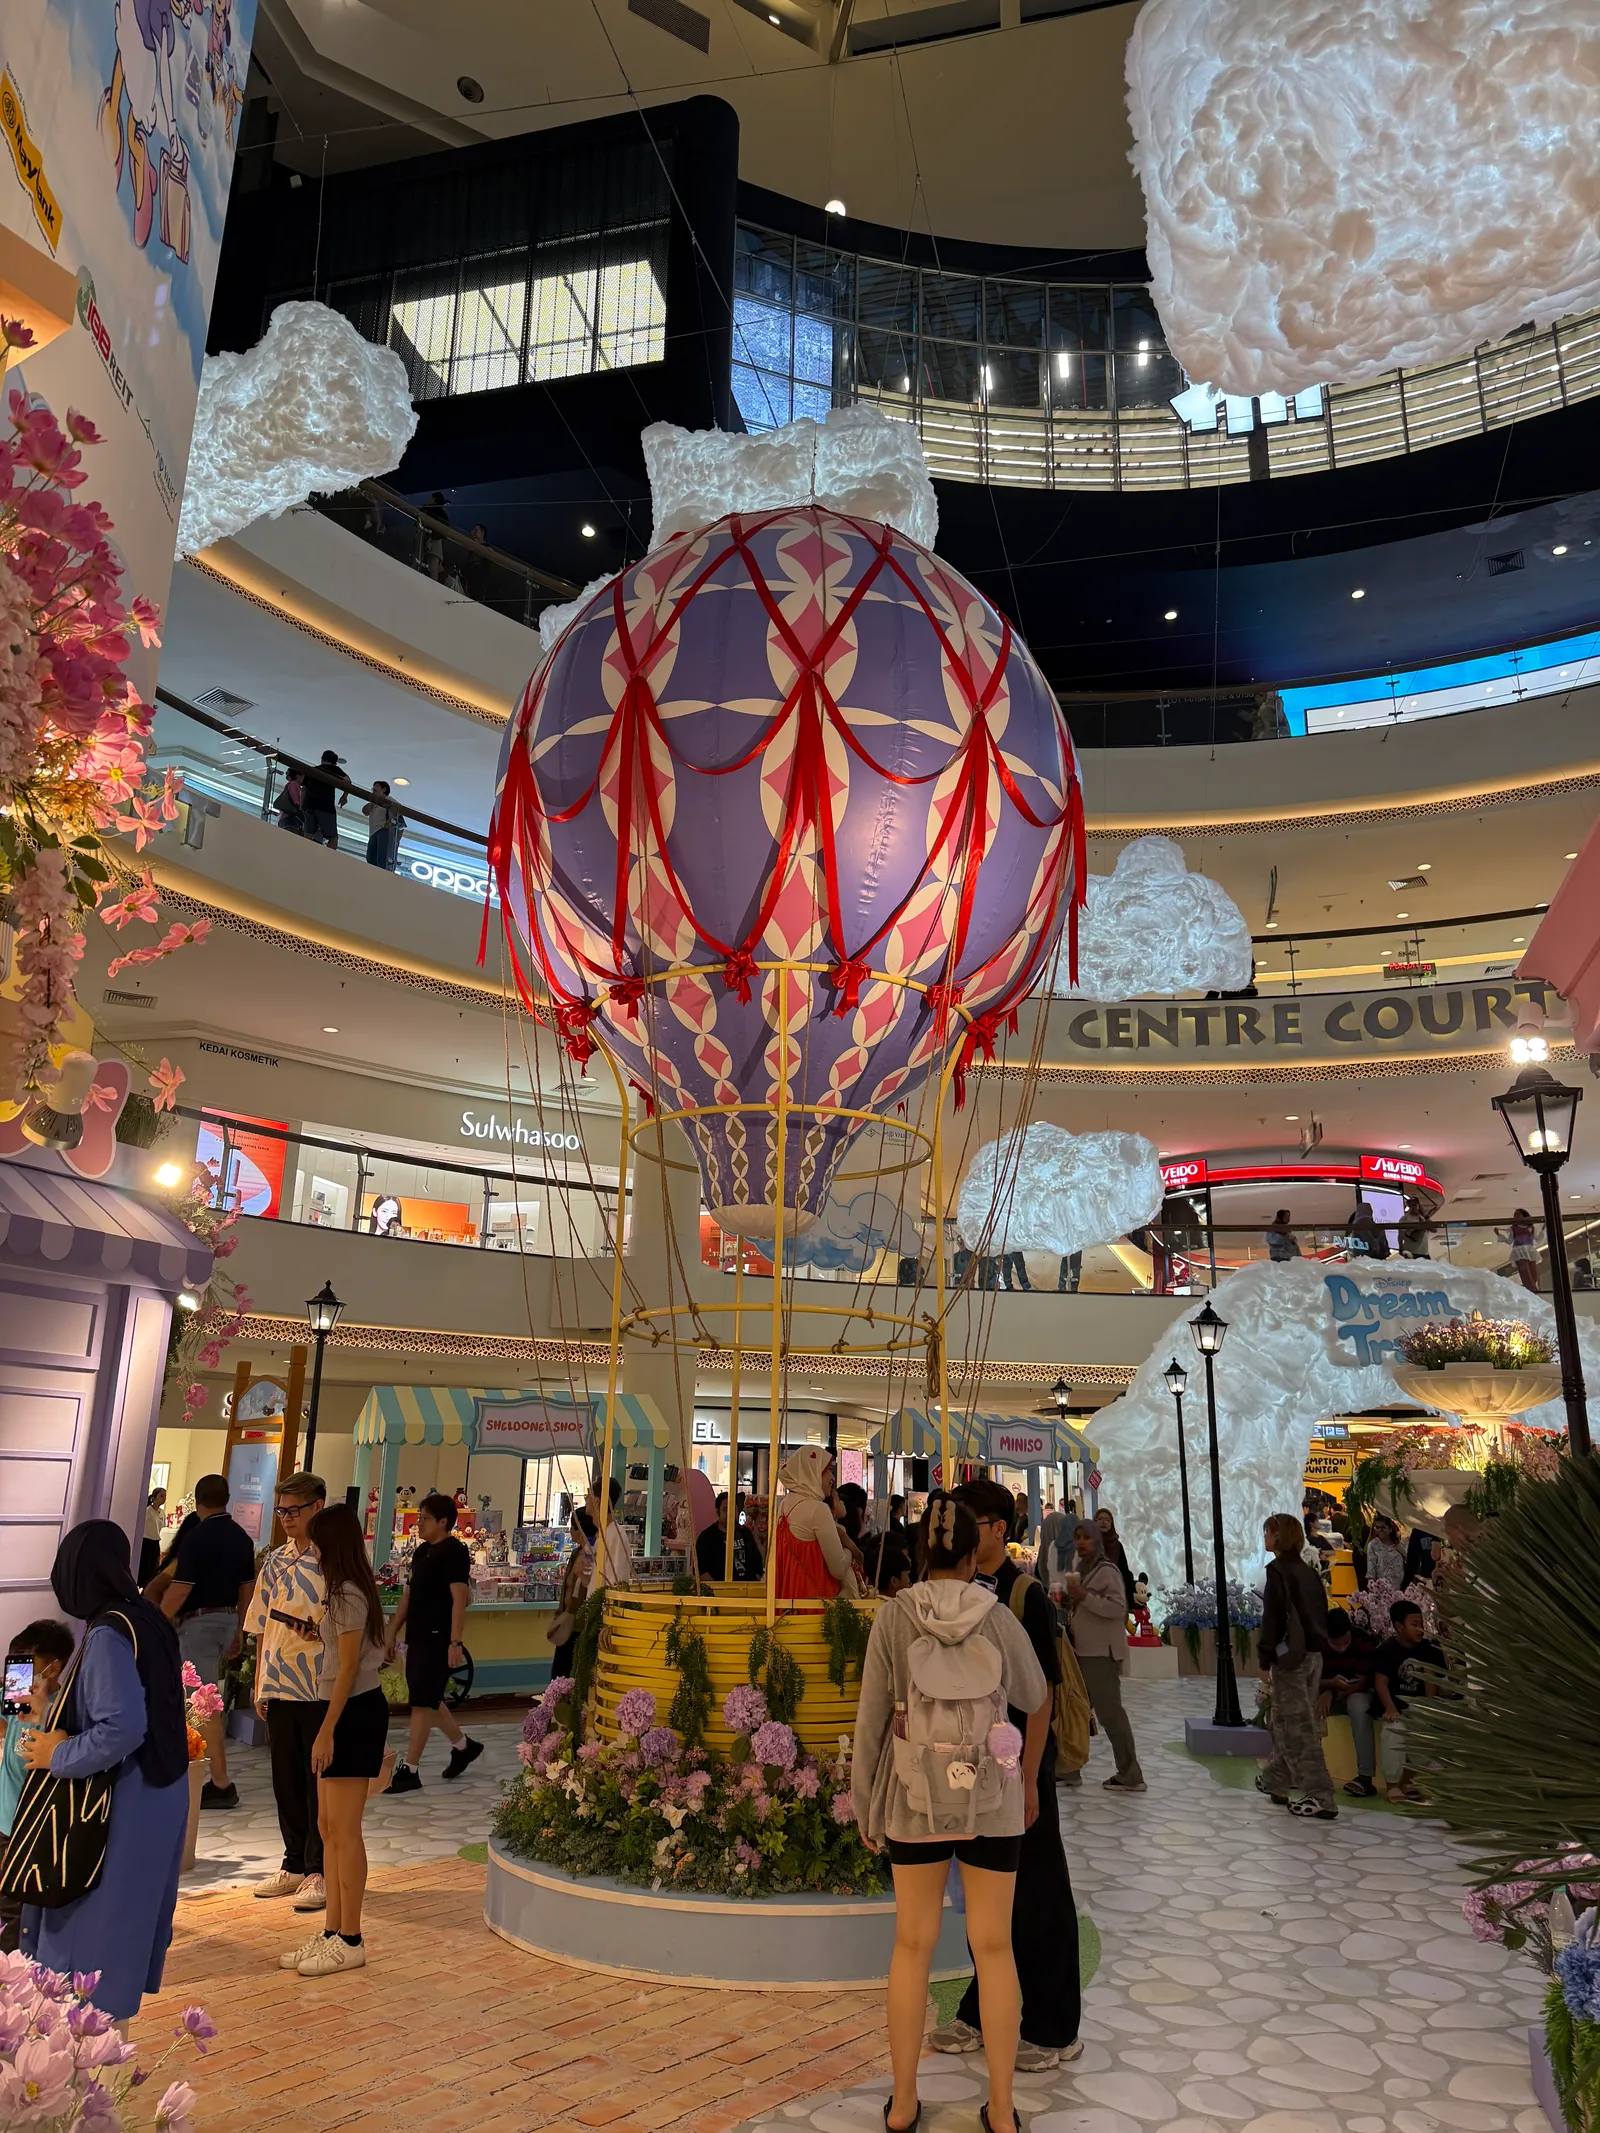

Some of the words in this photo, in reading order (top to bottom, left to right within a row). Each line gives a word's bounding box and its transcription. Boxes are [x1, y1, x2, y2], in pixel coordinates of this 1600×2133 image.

[87, 297, 111, 361] IGB
[109, 351, 134, 406] REIT
[411, 861, 497, 895] oppo
[1068, 1003, 1303, 1049] CENTRE
[1324, 982, 1561, 1042] COURT
[199, 1042, 229, 1056] KEDAI
[230, 1049, 280, 1068] KOSMETIK
[460, 1111, 580, 1150] Sulwhasoo
[1370, 1158, 1422, 1176] SHISEIDO
[1324, 1275, 1463, 1321] Dream
[553, 1421, 584, 1433] SHOP
[1000, 1436, 1043, 1453] MINISO
